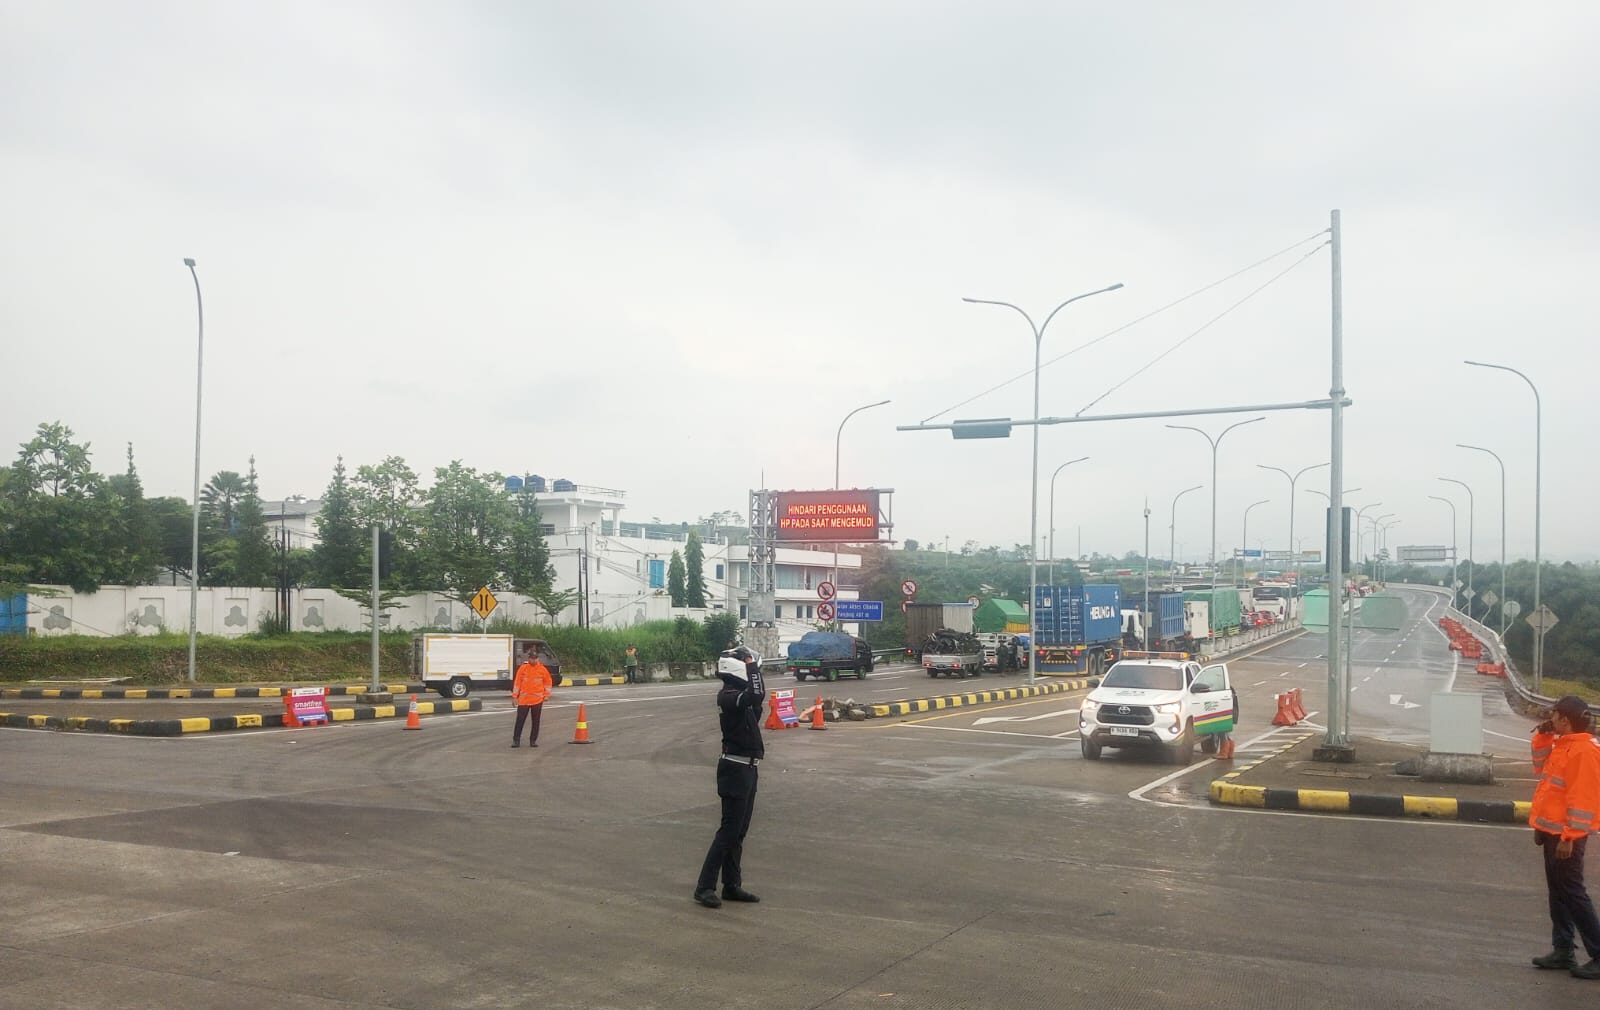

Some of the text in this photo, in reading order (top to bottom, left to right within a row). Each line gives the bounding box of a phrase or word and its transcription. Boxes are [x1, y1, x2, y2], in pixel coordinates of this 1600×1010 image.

[788, 504, 867, 515] HINDARI PENGGUNAAN
[781, 517, 874, 528] HP PADA SAAT MENGEMUDI
